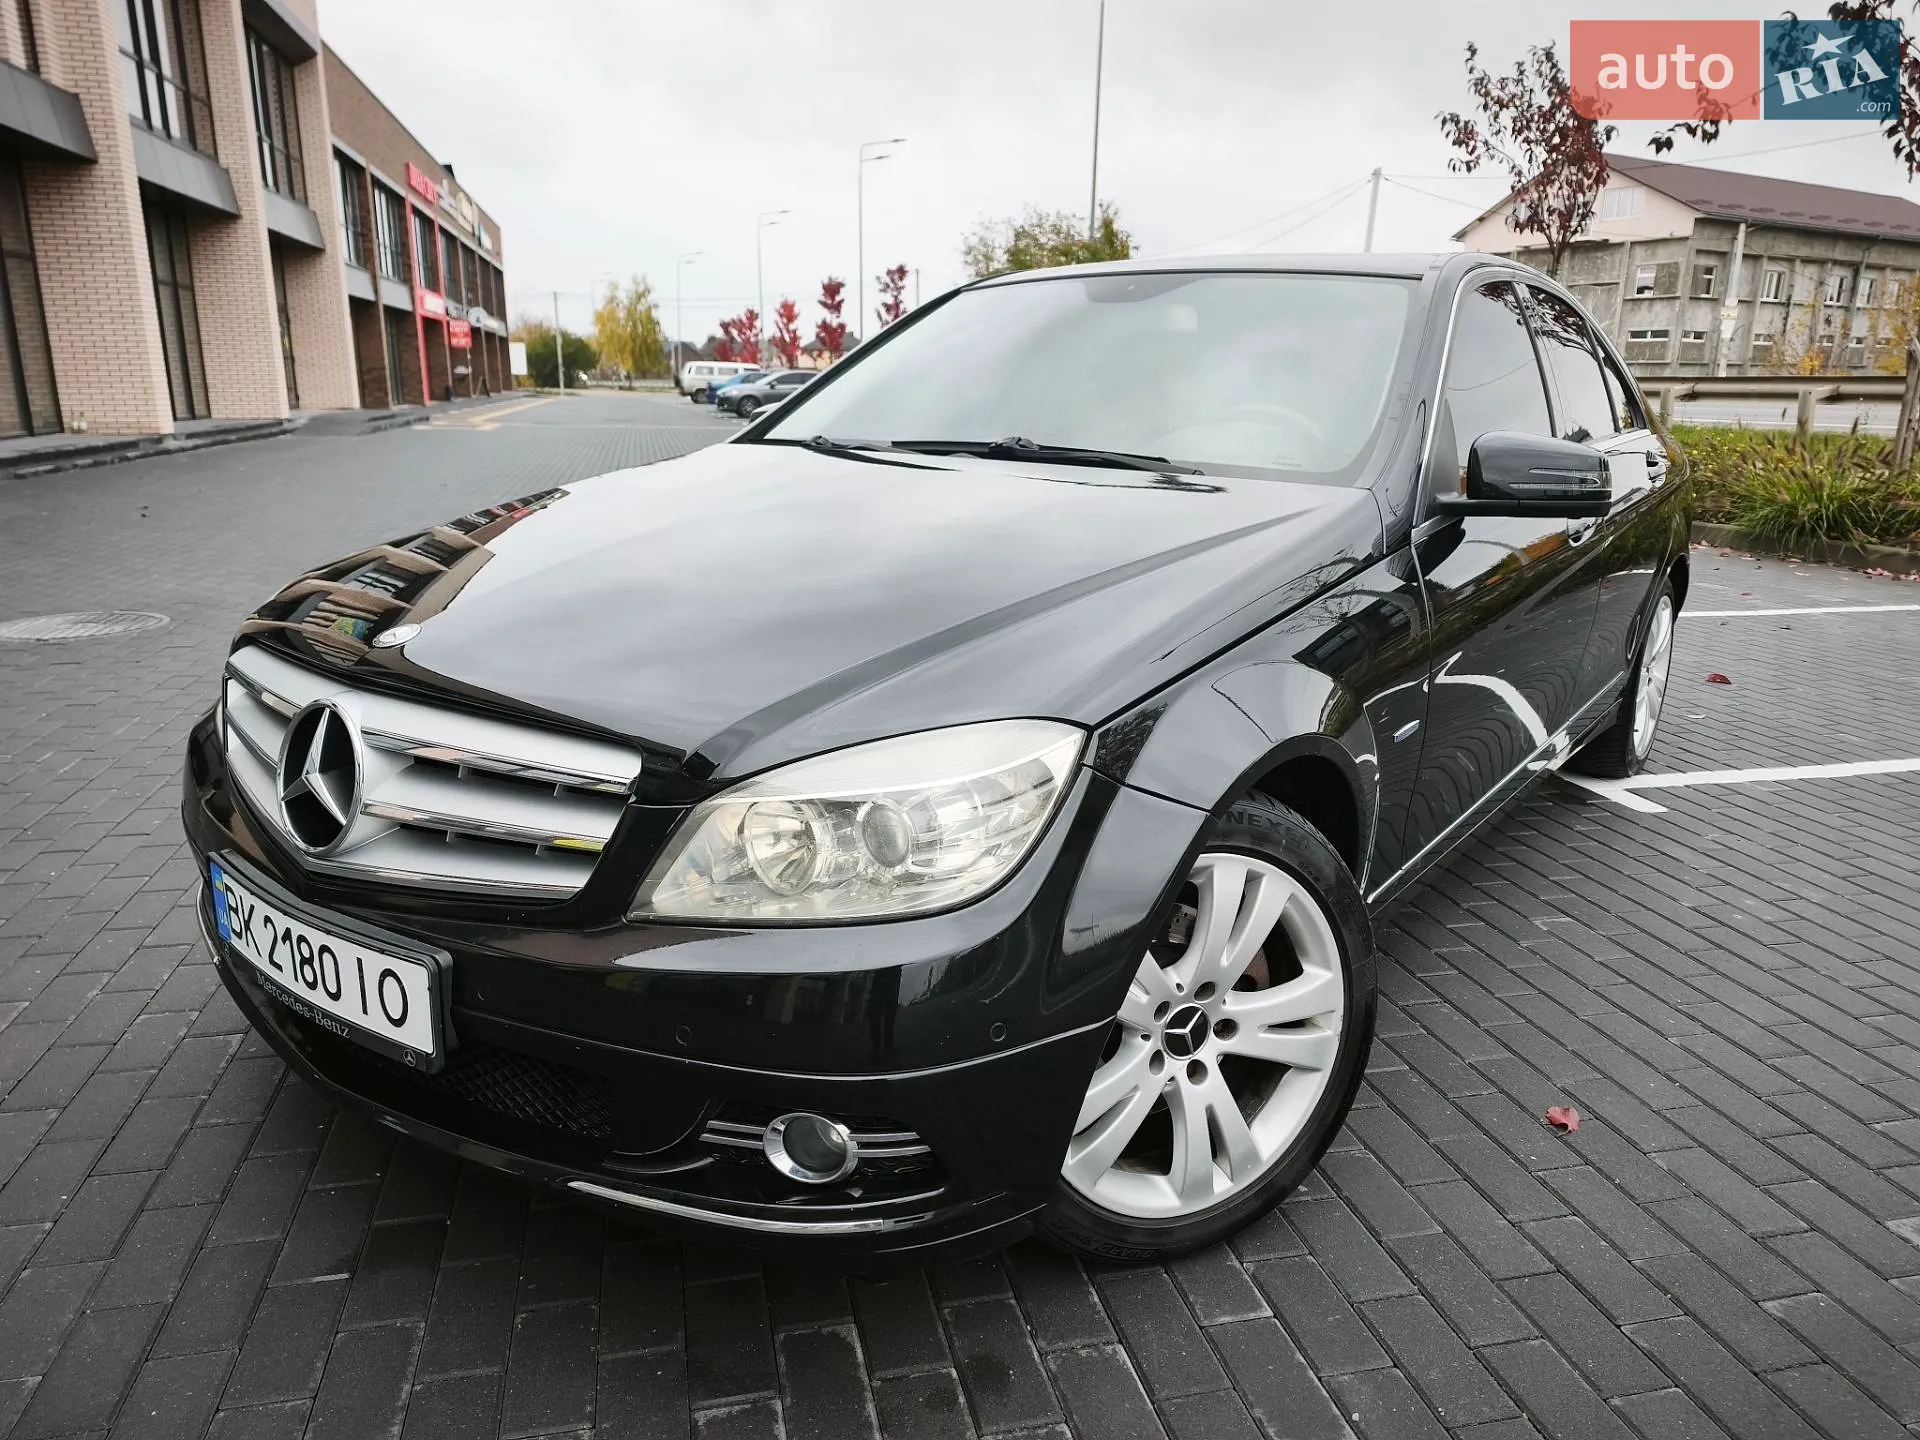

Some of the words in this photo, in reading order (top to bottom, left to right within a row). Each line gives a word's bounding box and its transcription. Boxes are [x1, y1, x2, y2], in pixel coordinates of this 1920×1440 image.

[224, 881, 263, 958] BK
[263, 914, 342, 1002] 2180
[356, 956, 409, 1028] IO
[256, 969, 351, 1039] Mercedes-Benz
